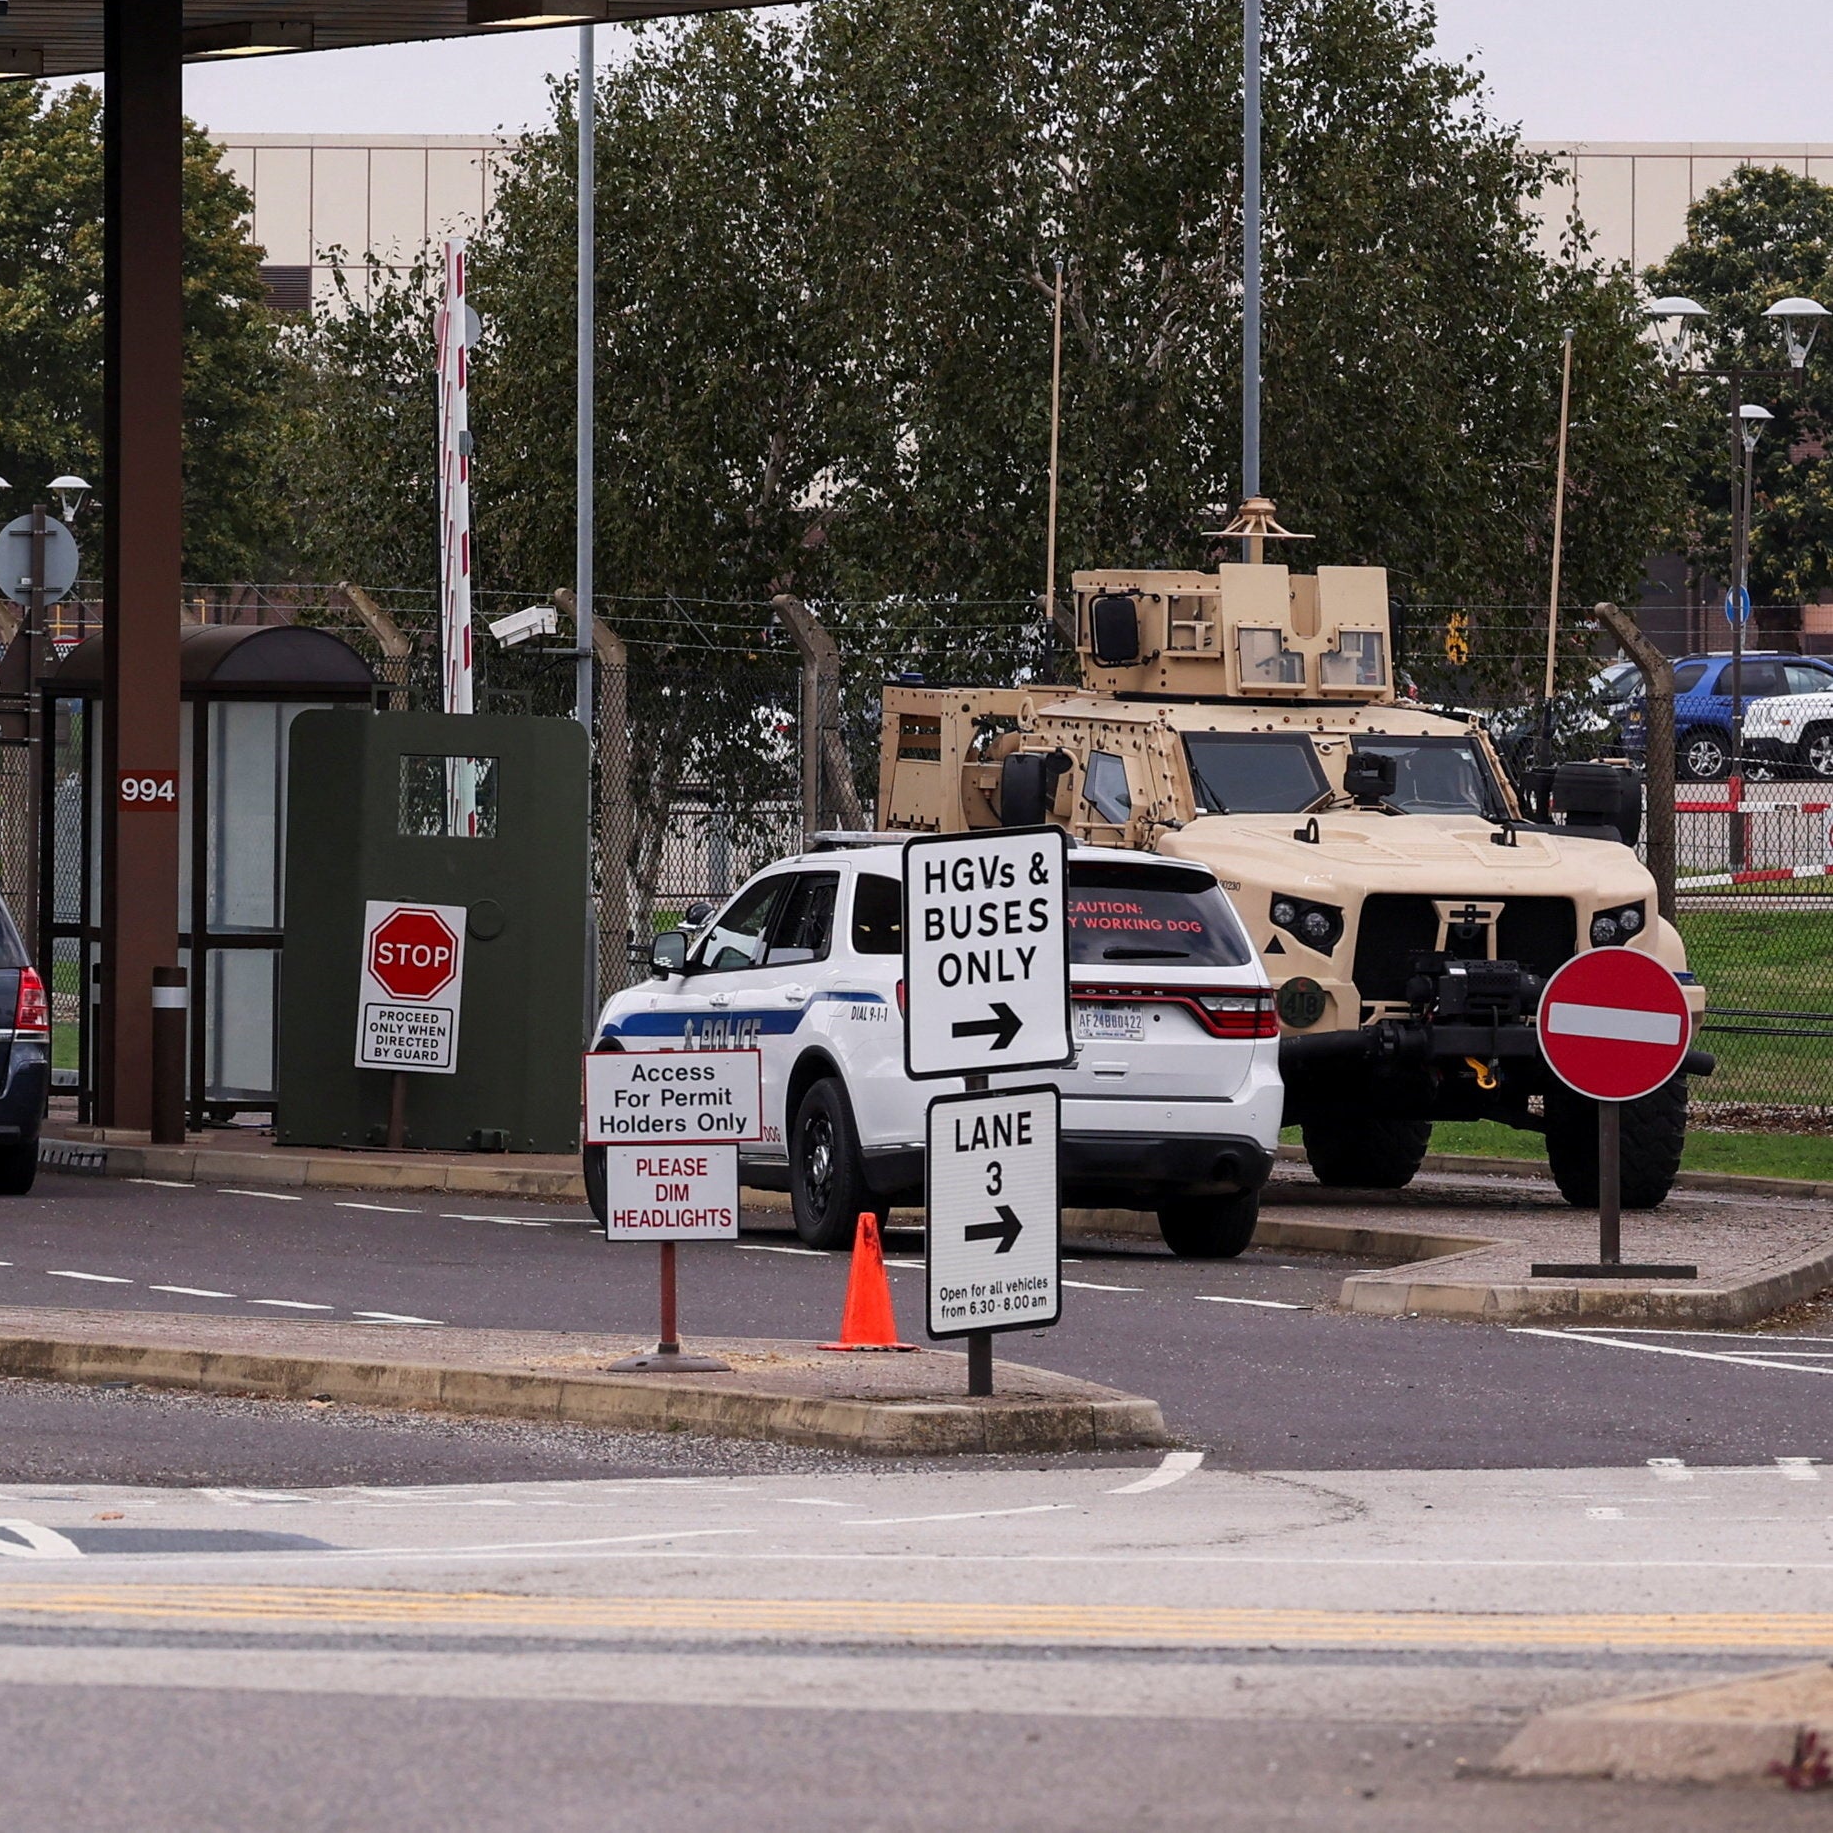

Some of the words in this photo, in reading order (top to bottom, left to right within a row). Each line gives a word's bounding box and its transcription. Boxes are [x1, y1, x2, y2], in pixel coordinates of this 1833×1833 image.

[121, 778, 175, 802] 994
[924, 855, 1015, 895] HGVs
[1028, 851, 1049, 886] &
[924, 897, 1049, 942] BUSES
[1084, 918, 1163, 931] WORKING
[1167, 920, 1202, 933] DOG
[377, 942, 449, 968] STOP
[938, 946, 1037, 988] ONLY
[379, 1010, 439, 1024] PROCEED
[851, 1005, 867, 1021] DIAL
[869, 1006, 888, 1022] 9-1-1
[369, 1022, 404, 1034] ONLY
[408, 1025, 446, 1037] WHEN
[376, 1035, 439, 1049] DIRECTED
[374, 1048, 390, 1058] BY
[394, 1049, 439, 1061] GUARD
[631, 1063, 715, 1082] Access
[614, 1089, 651, 1108] For
[661, 1087, 733, 1107] Permit
[599, 1115, 687, 1134] Holders
[697, 1112, 747, 1134] Only
[955, 1110, 1033, 1153] LANE
[763, 1126, 781, 1143] DOG
[636, 1158, 708, 1177] PLEASE
[985, 1160, 1003, 1197] 3
[655, 1183, 690, 1202] DIM
[613, 1208, 732, 1228] HEADLIGHTS
[940, 1286, 968, 1303] Open
[971, 1283, 986, 1297] for
[989, 1280, 1003, 1295] all
[1006, 1276, 1048, 1293] vehicles
[941, 1304, 966, 1319] from
[1031, 1294, 1047, 1308] am
